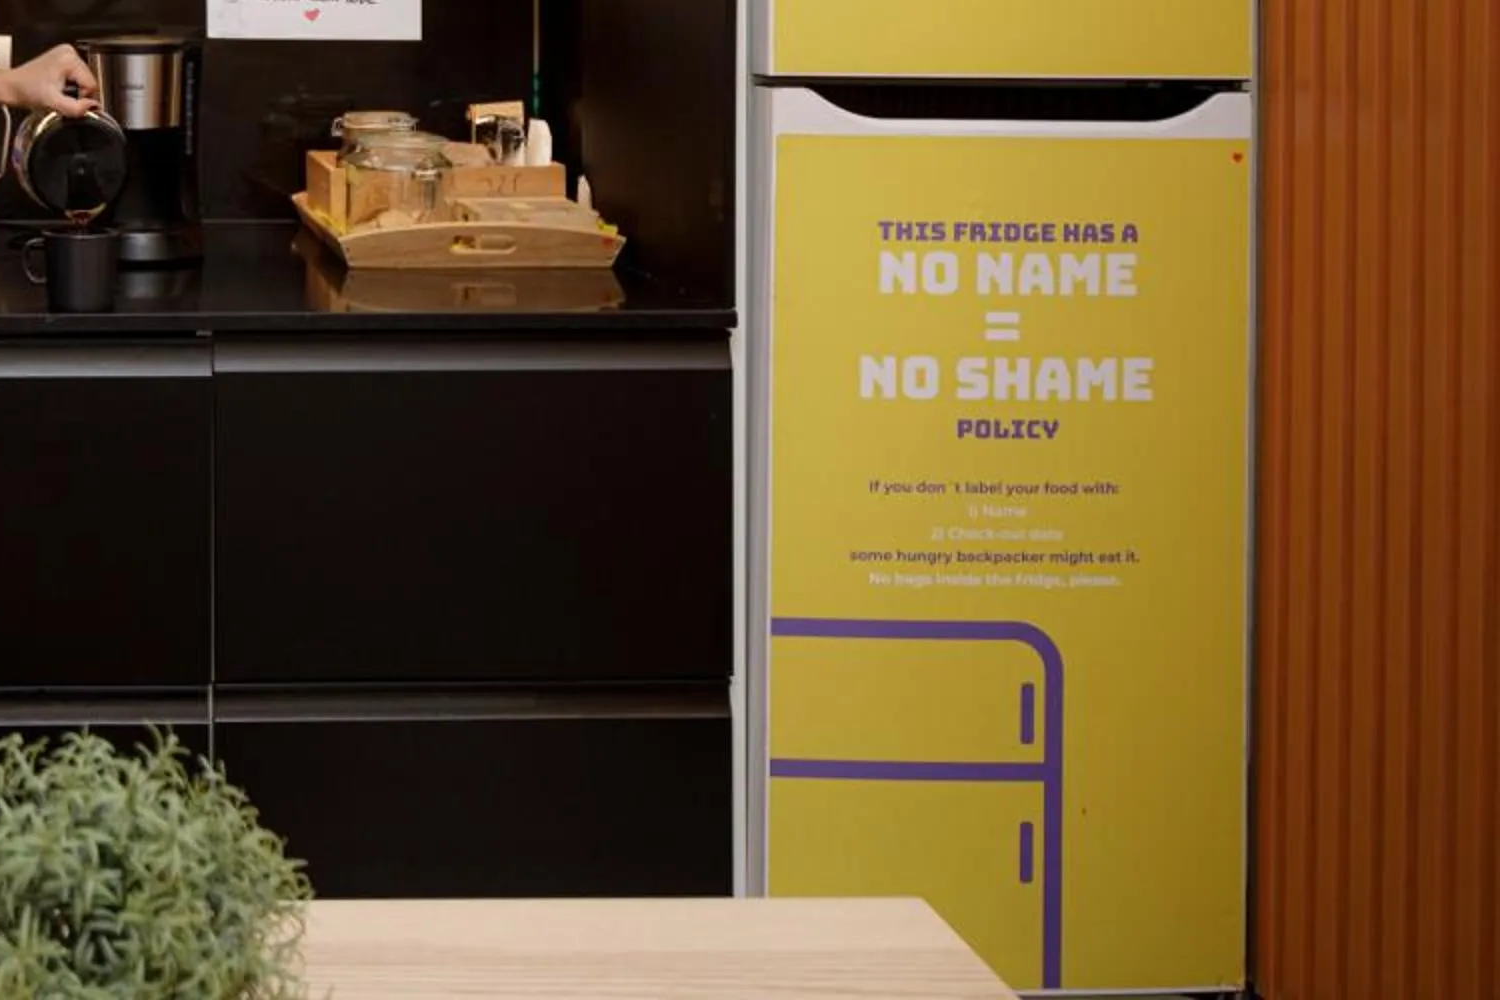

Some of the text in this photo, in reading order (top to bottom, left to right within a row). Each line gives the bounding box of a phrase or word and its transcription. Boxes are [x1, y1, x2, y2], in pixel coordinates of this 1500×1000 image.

[879, 222, 1138, 243] THIS FRIDGE HAS A
[879, 251, 1138, 296] NO NAME
[985, 311, 1020, 341] =
[859, 355, 1154, 401] NO SHAME
[957, 419, 1059, 439] POLICY
[869, 480, 880, 493] If
[884, 483, 911, 495] you
[965, 481, 1002, 494] label
[1006, 484, 1039, 496] your
[1045, 481, 1078, 494] food
[850, 551, 892, 560] some
[897, 549, 952, 565] hungry
[957, 550, 1043, 565] backpacker
[1050, 550, 1094, 566] might
[1098, 551, 1120, 563] eat
